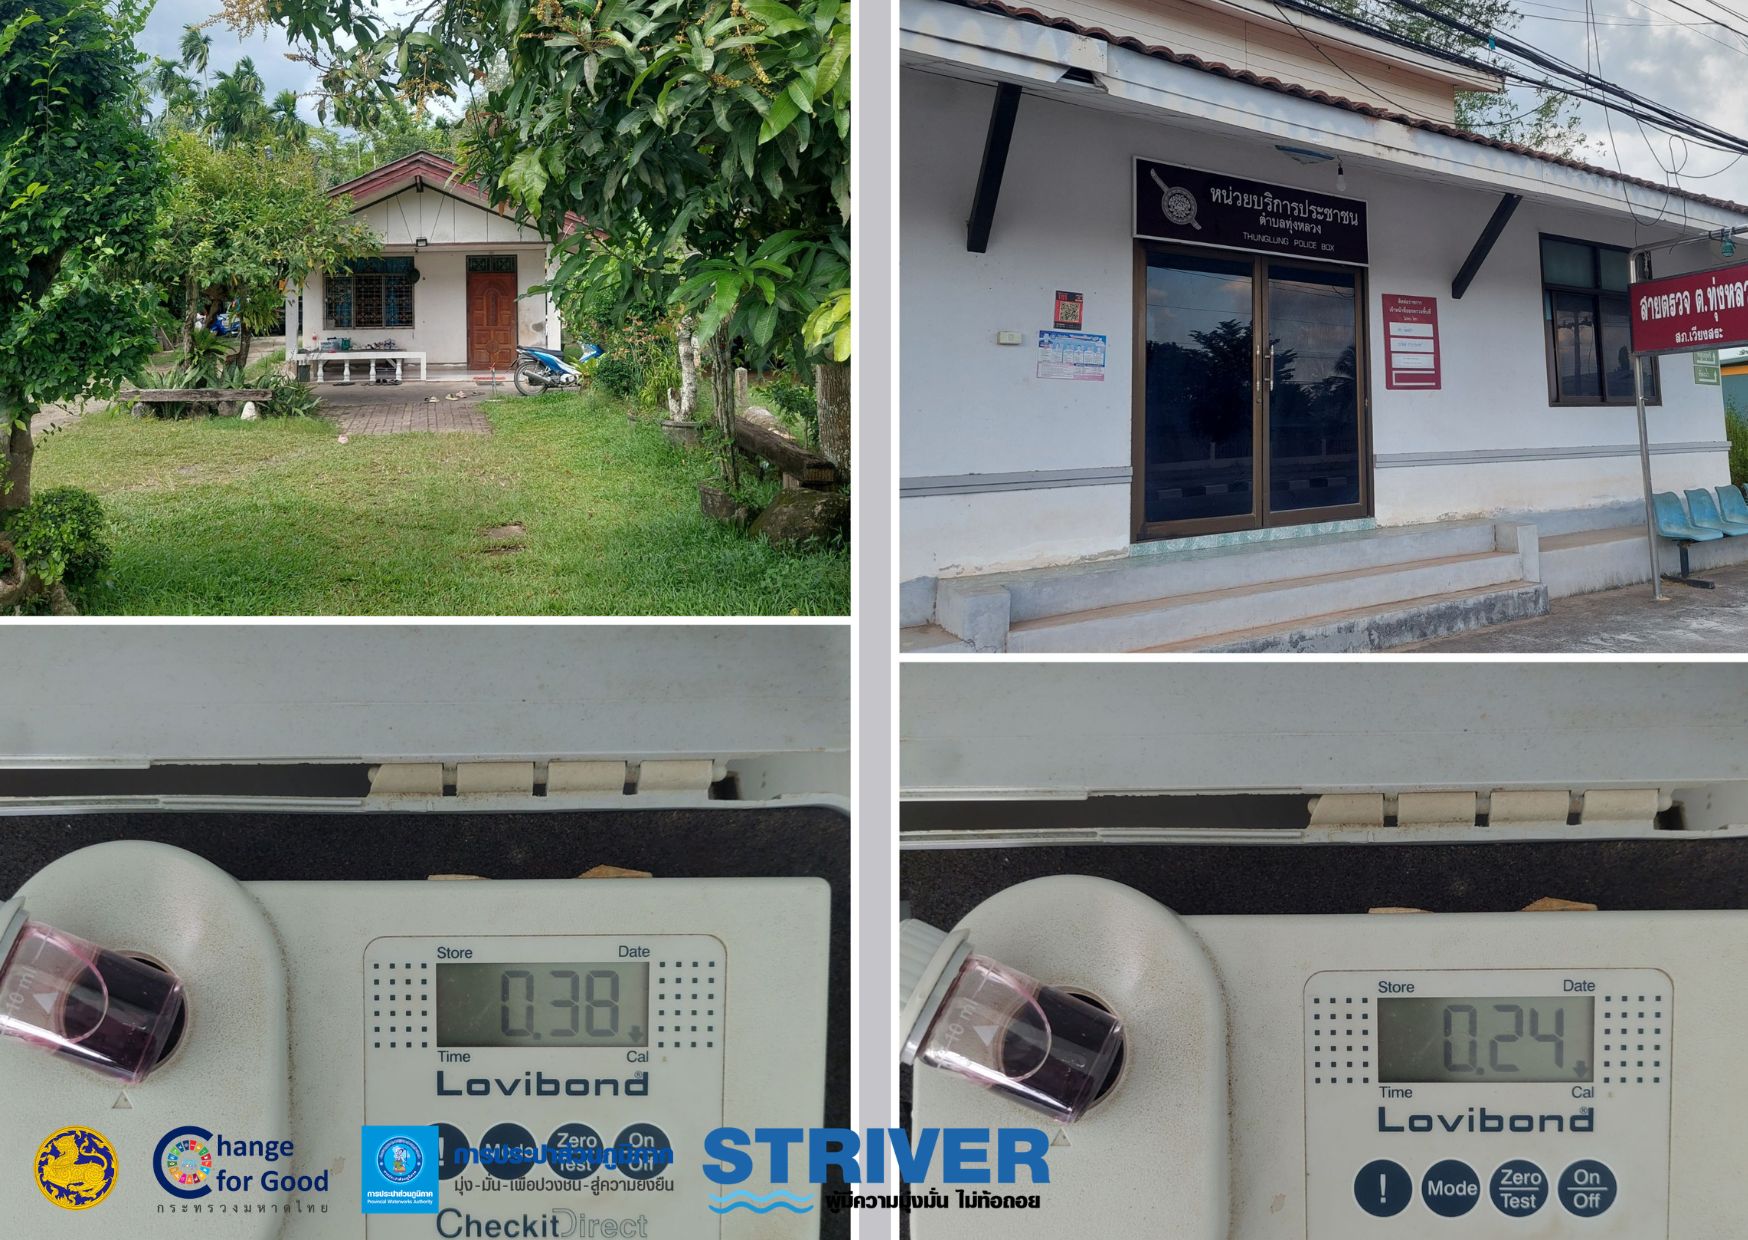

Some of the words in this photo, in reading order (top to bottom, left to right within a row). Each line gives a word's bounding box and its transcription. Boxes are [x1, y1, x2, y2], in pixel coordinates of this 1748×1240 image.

[1210, 186, 1359, 226] หน่วยบริการประชาชน
[1259, 212, 1322, 235] ตำบลทุ่งหลวง
[1243, 231, 1289, 246] THUNGLUNG
[1293, 239, 1317, 250] POLICE
[1321, 243, 1335, 252] BOX
[1639, 290, 1691, 321] สายตรวจ
[1675, 326, 1724, 343] สภ.เวียงสระ
[436, 946, 473, 959] Store
[618, 945, 650, 958] Date
[1377, 979, 1415, 994] Store
[1563, 979, 1596, 993] Date
[501, 970, 620, 1040] 0.38
[1443, 1004, 1564, 1076] 0.24
[437, 1050, 471, 1063] Time
[626, 1049, 649, 1063] Cal
[1379, 1086, 1413, 1099] Time
[1571, 1086, 1595, 1099] Cal
[557, 1133, 597, 1148] Zero
[629, 1132, 654, 1148] On
[1500, 1169, 1542, 1185] Zero
[1573, 1168, 1601, 1185] On
[1427, 1180, 1479, 1196] Mode
[1500, 1193, 1537, 1209] Test
[1573, 1193, 1601, 1209] Off
